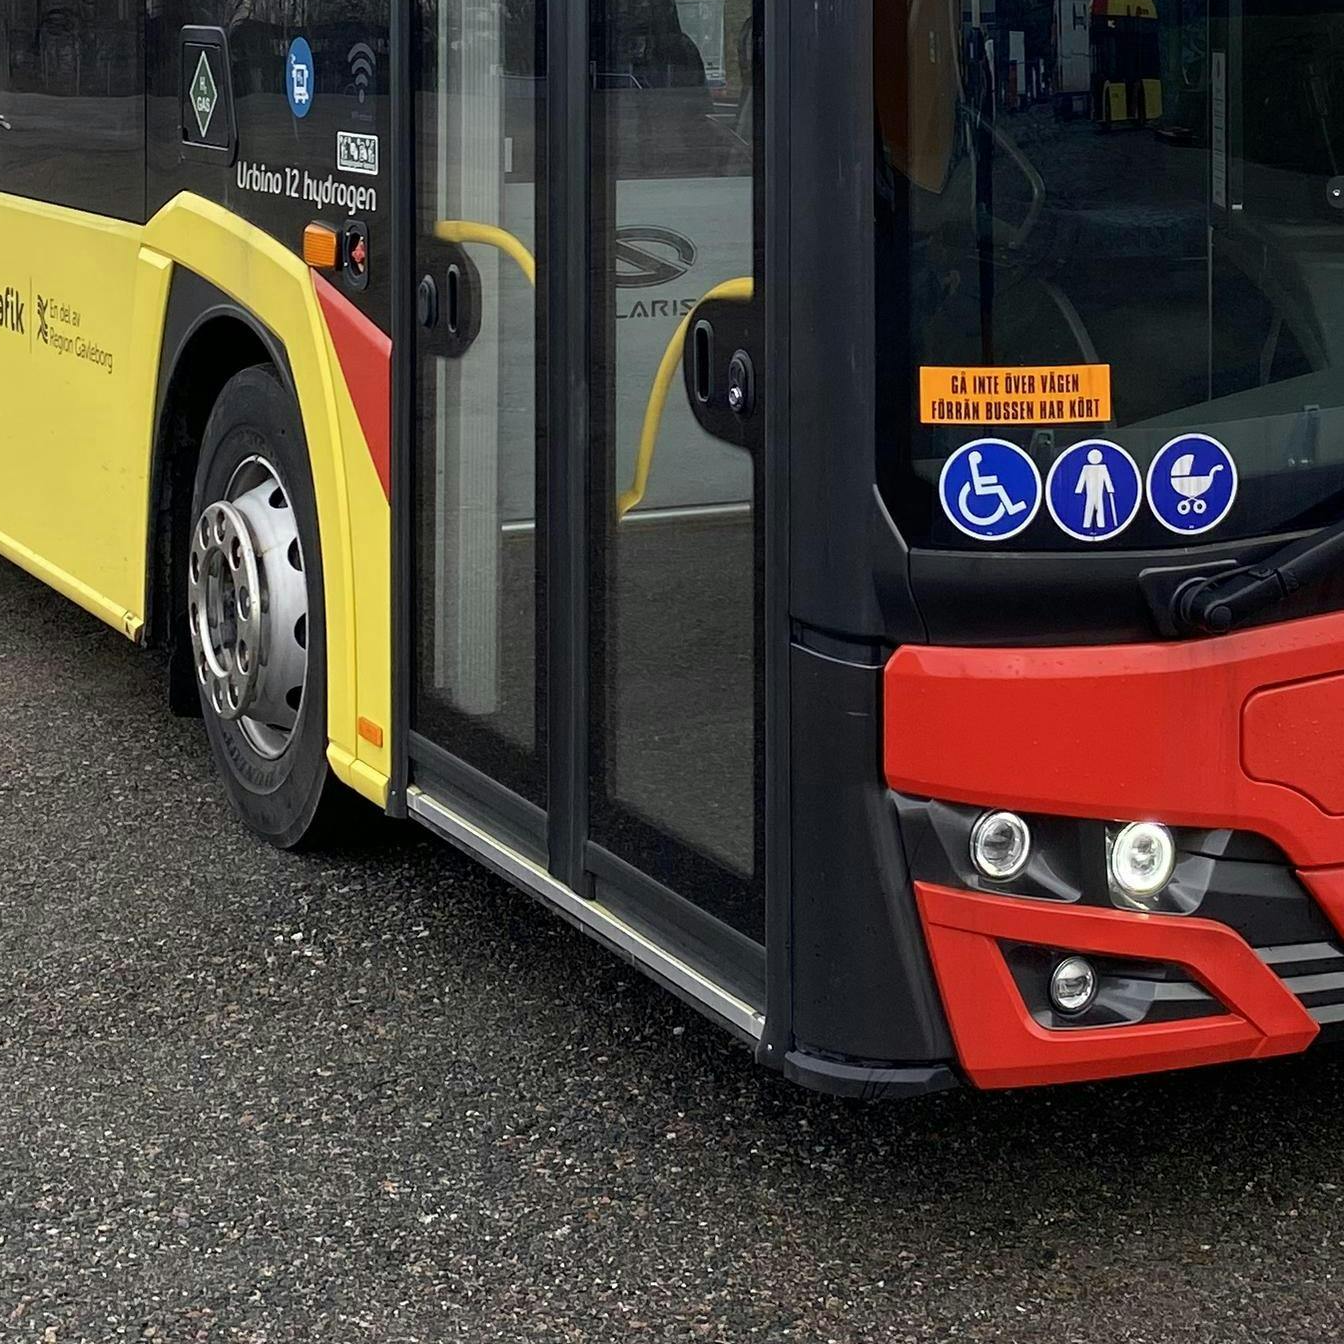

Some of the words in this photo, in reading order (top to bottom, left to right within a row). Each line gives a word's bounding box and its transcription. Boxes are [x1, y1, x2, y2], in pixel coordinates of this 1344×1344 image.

[197, 96, 211, 113] GAS
[237, 160, 282, 195] Urbino
[285, 167, 300, 198] 12
[303, 170, 377, 216] hydrogen
[50, 298, 58, 319] En
[60, 302, 71, 325] del
[72, 311, 81, 328] av
[49, 326, 74, 356] Region
[75, 336, 113, 375] Gävleborg
[951, 371, 967, 394] GÅ
[973, 375, 999, 395] INTE
[1005, 372, 1035, 394] ÖVER
[1040, 371, 1079, 393] VÄGEN
[931, 398, 980, 420] FÖRRÄN
[985, 400, 1034, 420] BUSSEN
[1039, 400, 1064, 419] HAR
[1069, 396, 1100, 419] KÖRT
